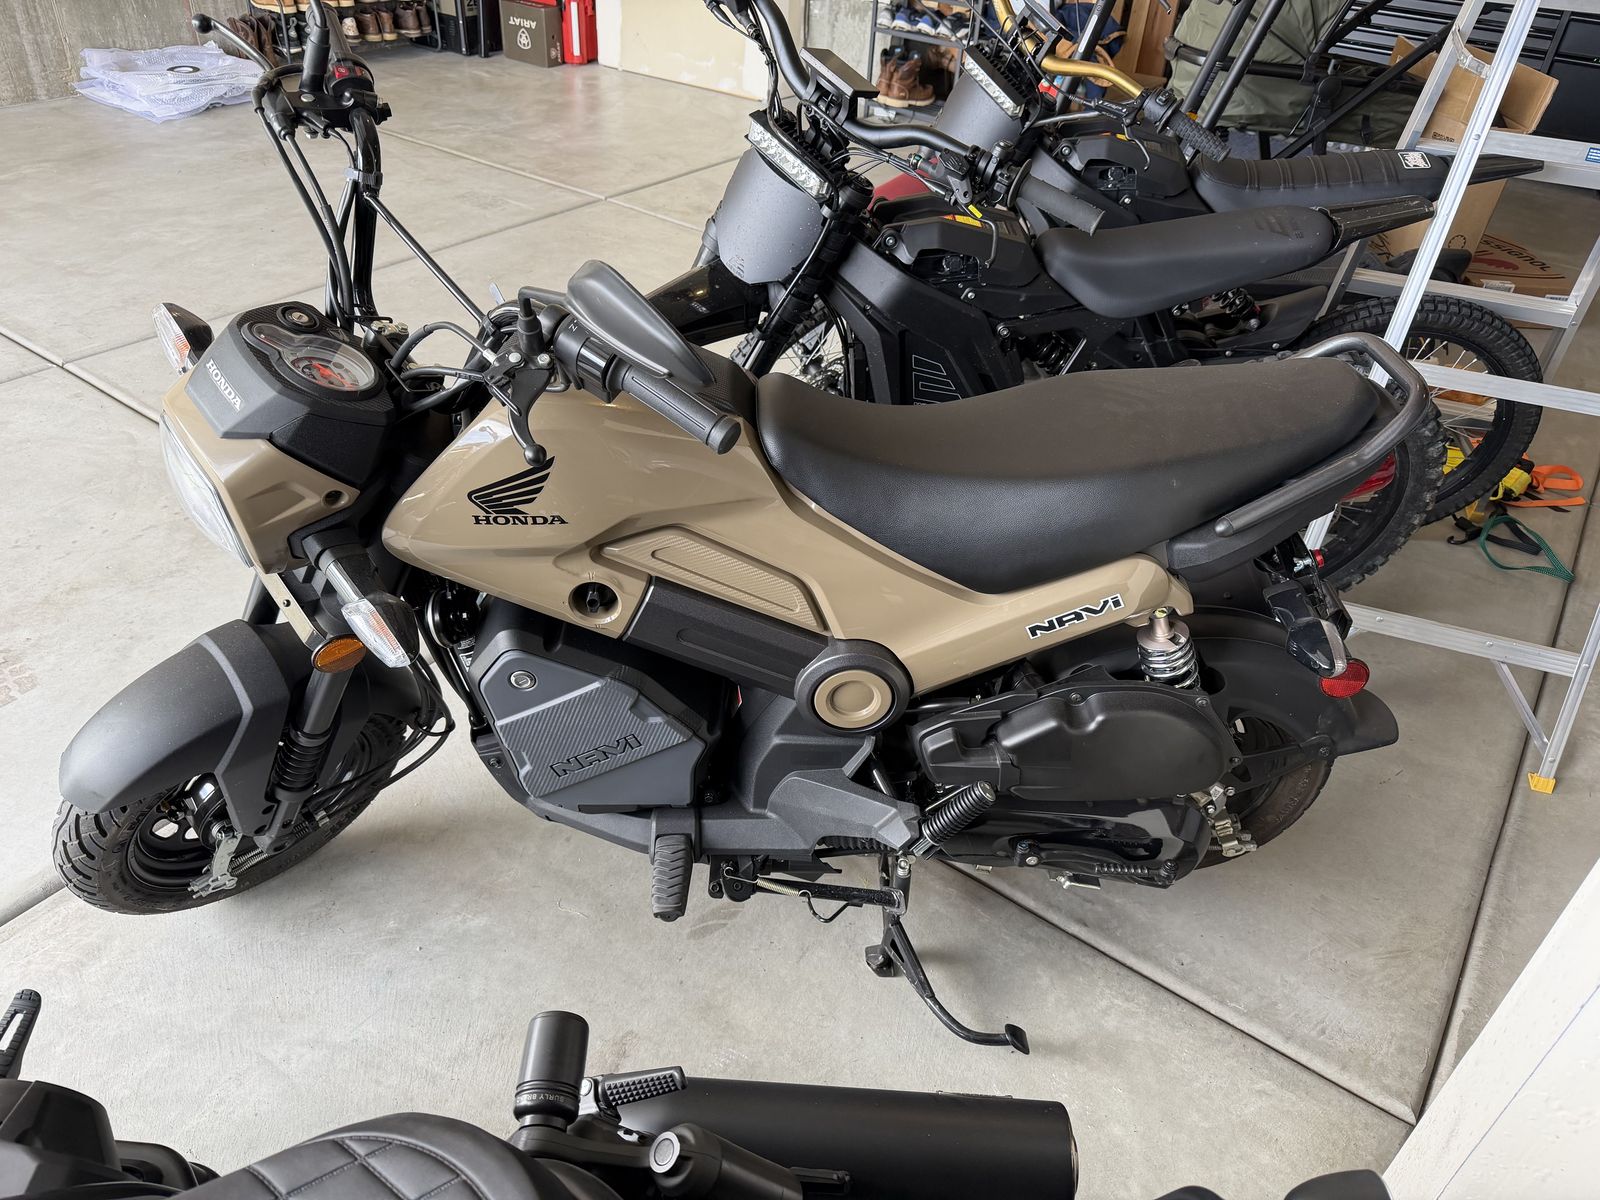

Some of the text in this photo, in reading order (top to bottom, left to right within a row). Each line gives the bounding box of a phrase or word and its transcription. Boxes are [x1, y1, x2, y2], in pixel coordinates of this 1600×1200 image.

[508, 16, 537, 30] ARIAT
[206, 358, 244, 412] HONDA
[472, 514, 569, 526] HONDA
